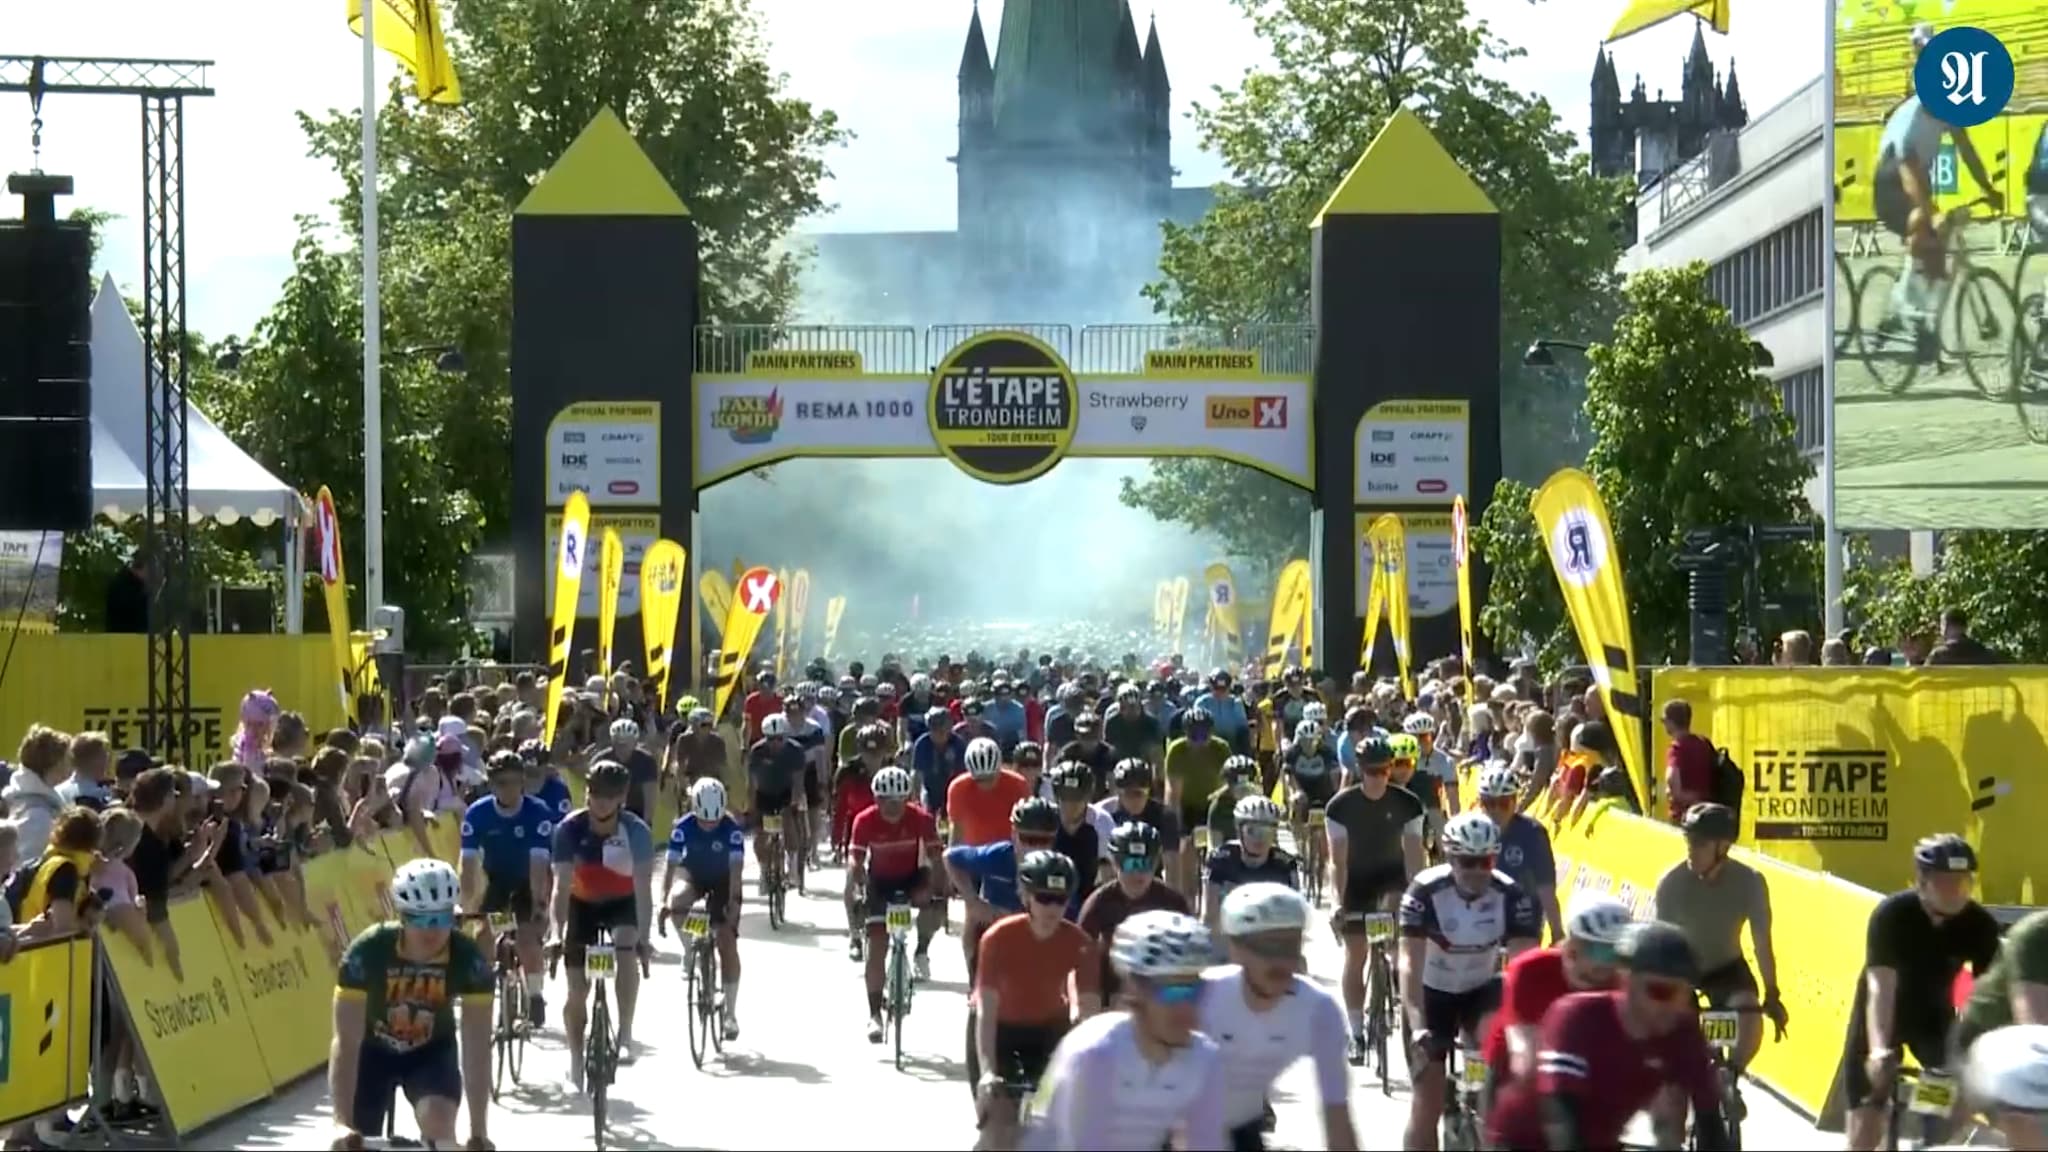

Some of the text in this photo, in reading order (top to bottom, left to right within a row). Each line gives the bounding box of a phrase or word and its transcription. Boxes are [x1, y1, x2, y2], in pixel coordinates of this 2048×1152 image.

[752, 354, 856, 369] MAIN PARTNERS
[1150, 354, 1254, 369] MAIN PARTNERS
[796, 401, 914, 419] REMA 1000
[1089, 391, 1189, 411] Strawberry
[945, 407, 1061, 426] TRONDHEIM
[1755, 797, 1888, 818] TRONDHEIM
[144, 992, 217, 1039] Strawberry
